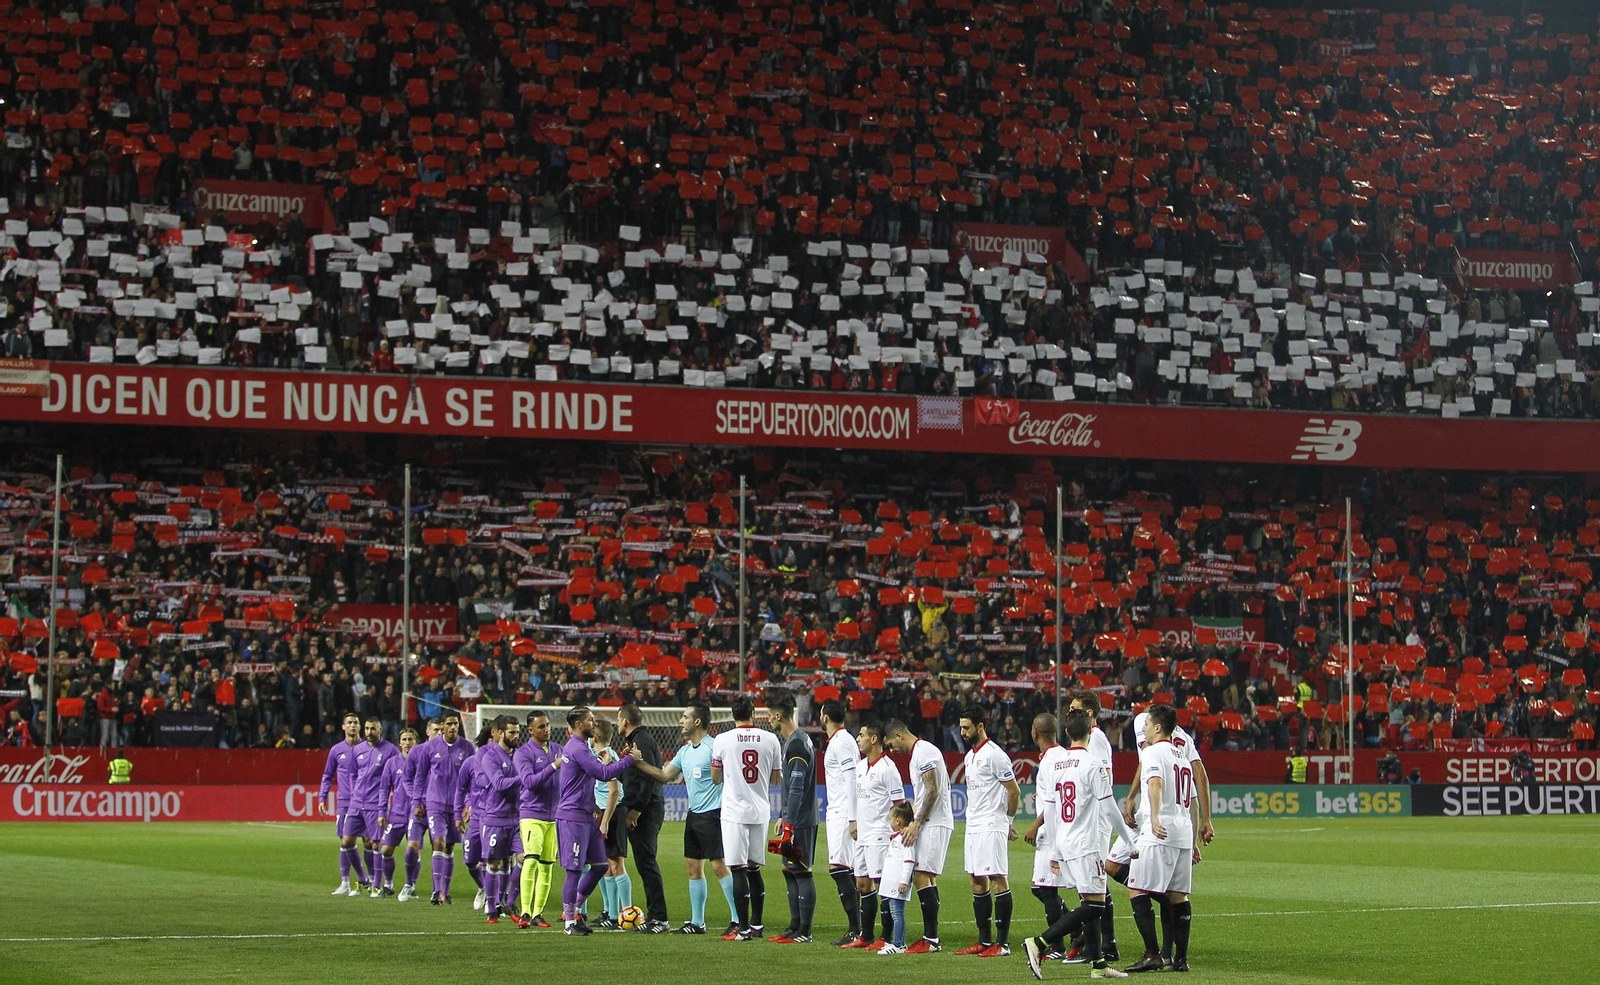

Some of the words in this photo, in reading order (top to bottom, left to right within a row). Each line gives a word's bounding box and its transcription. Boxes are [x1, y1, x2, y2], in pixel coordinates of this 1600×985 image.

[194, 187, 303, 217] Cruzcampo
[1457, 257, 1553, 282] Cruzcampo
[41, 373, 168, 416] DICEN
[185, 379, 267, 421] QUE
[284, 382, 429, 425] NUNCA
[446, 387, 494, 428] SE
[512, 390, 634, 432] RINDE
[716, 399, 910, 440] SEEPUERTORICO.COM
[742, 749, 758, 784] 8
[1446, 758, 1600, 783] SEEPERTO
[1173, 764, 1191, 808] 10
[12, 783, 181, 822] Cruzcampo
[1055, 781, 1076, 823] 18
[1211, 790, 1300, 814] bet365
[1316, 790, 1402, 814] bet365
[489, 833, 497, 847] 6
[572, 842, 580, 857] 4
